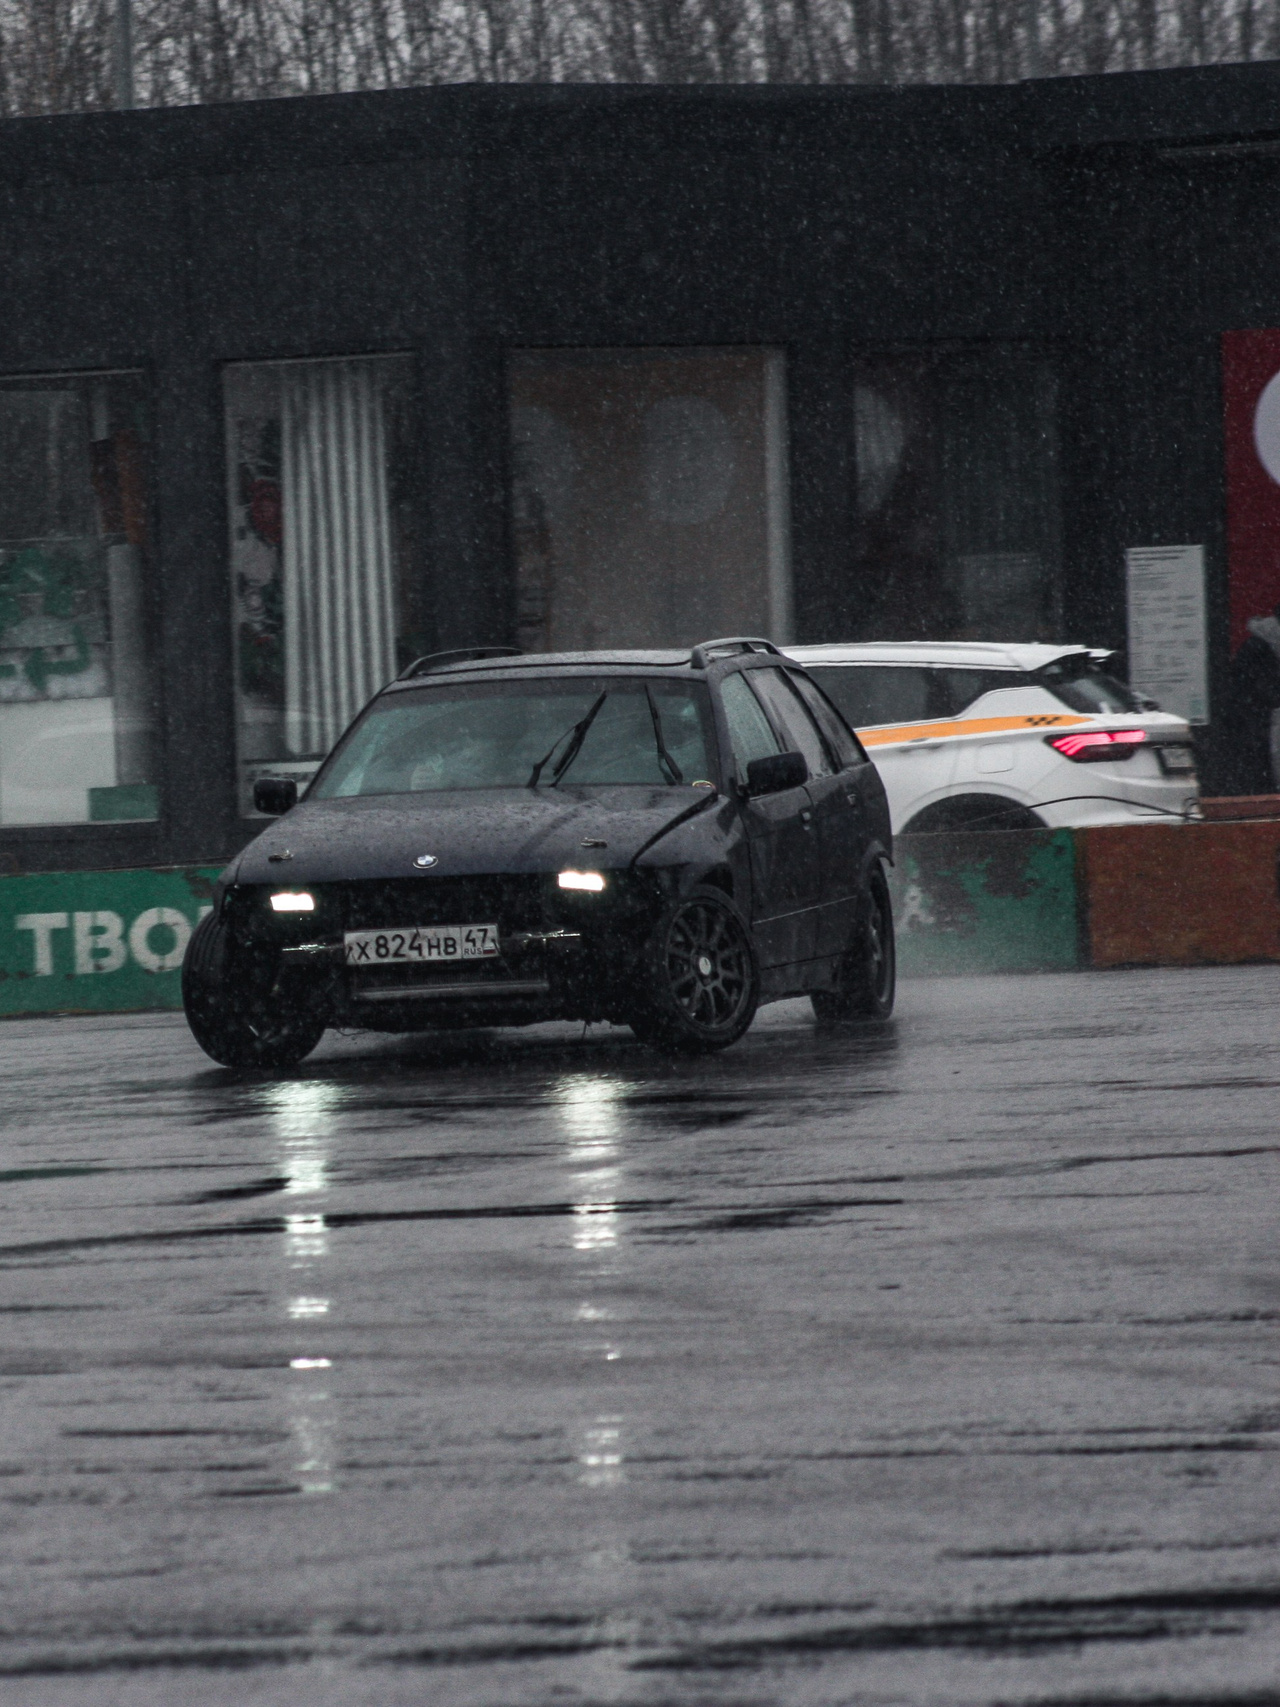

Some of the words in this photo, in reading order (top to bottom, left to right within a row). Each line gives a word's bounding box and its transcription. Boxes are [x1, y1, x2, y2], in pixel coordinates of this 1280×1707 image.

[15, 905, 215, 977] ТВО
[464, 928, 489, 948] 47
[463, 947, 483, 956] RUS
